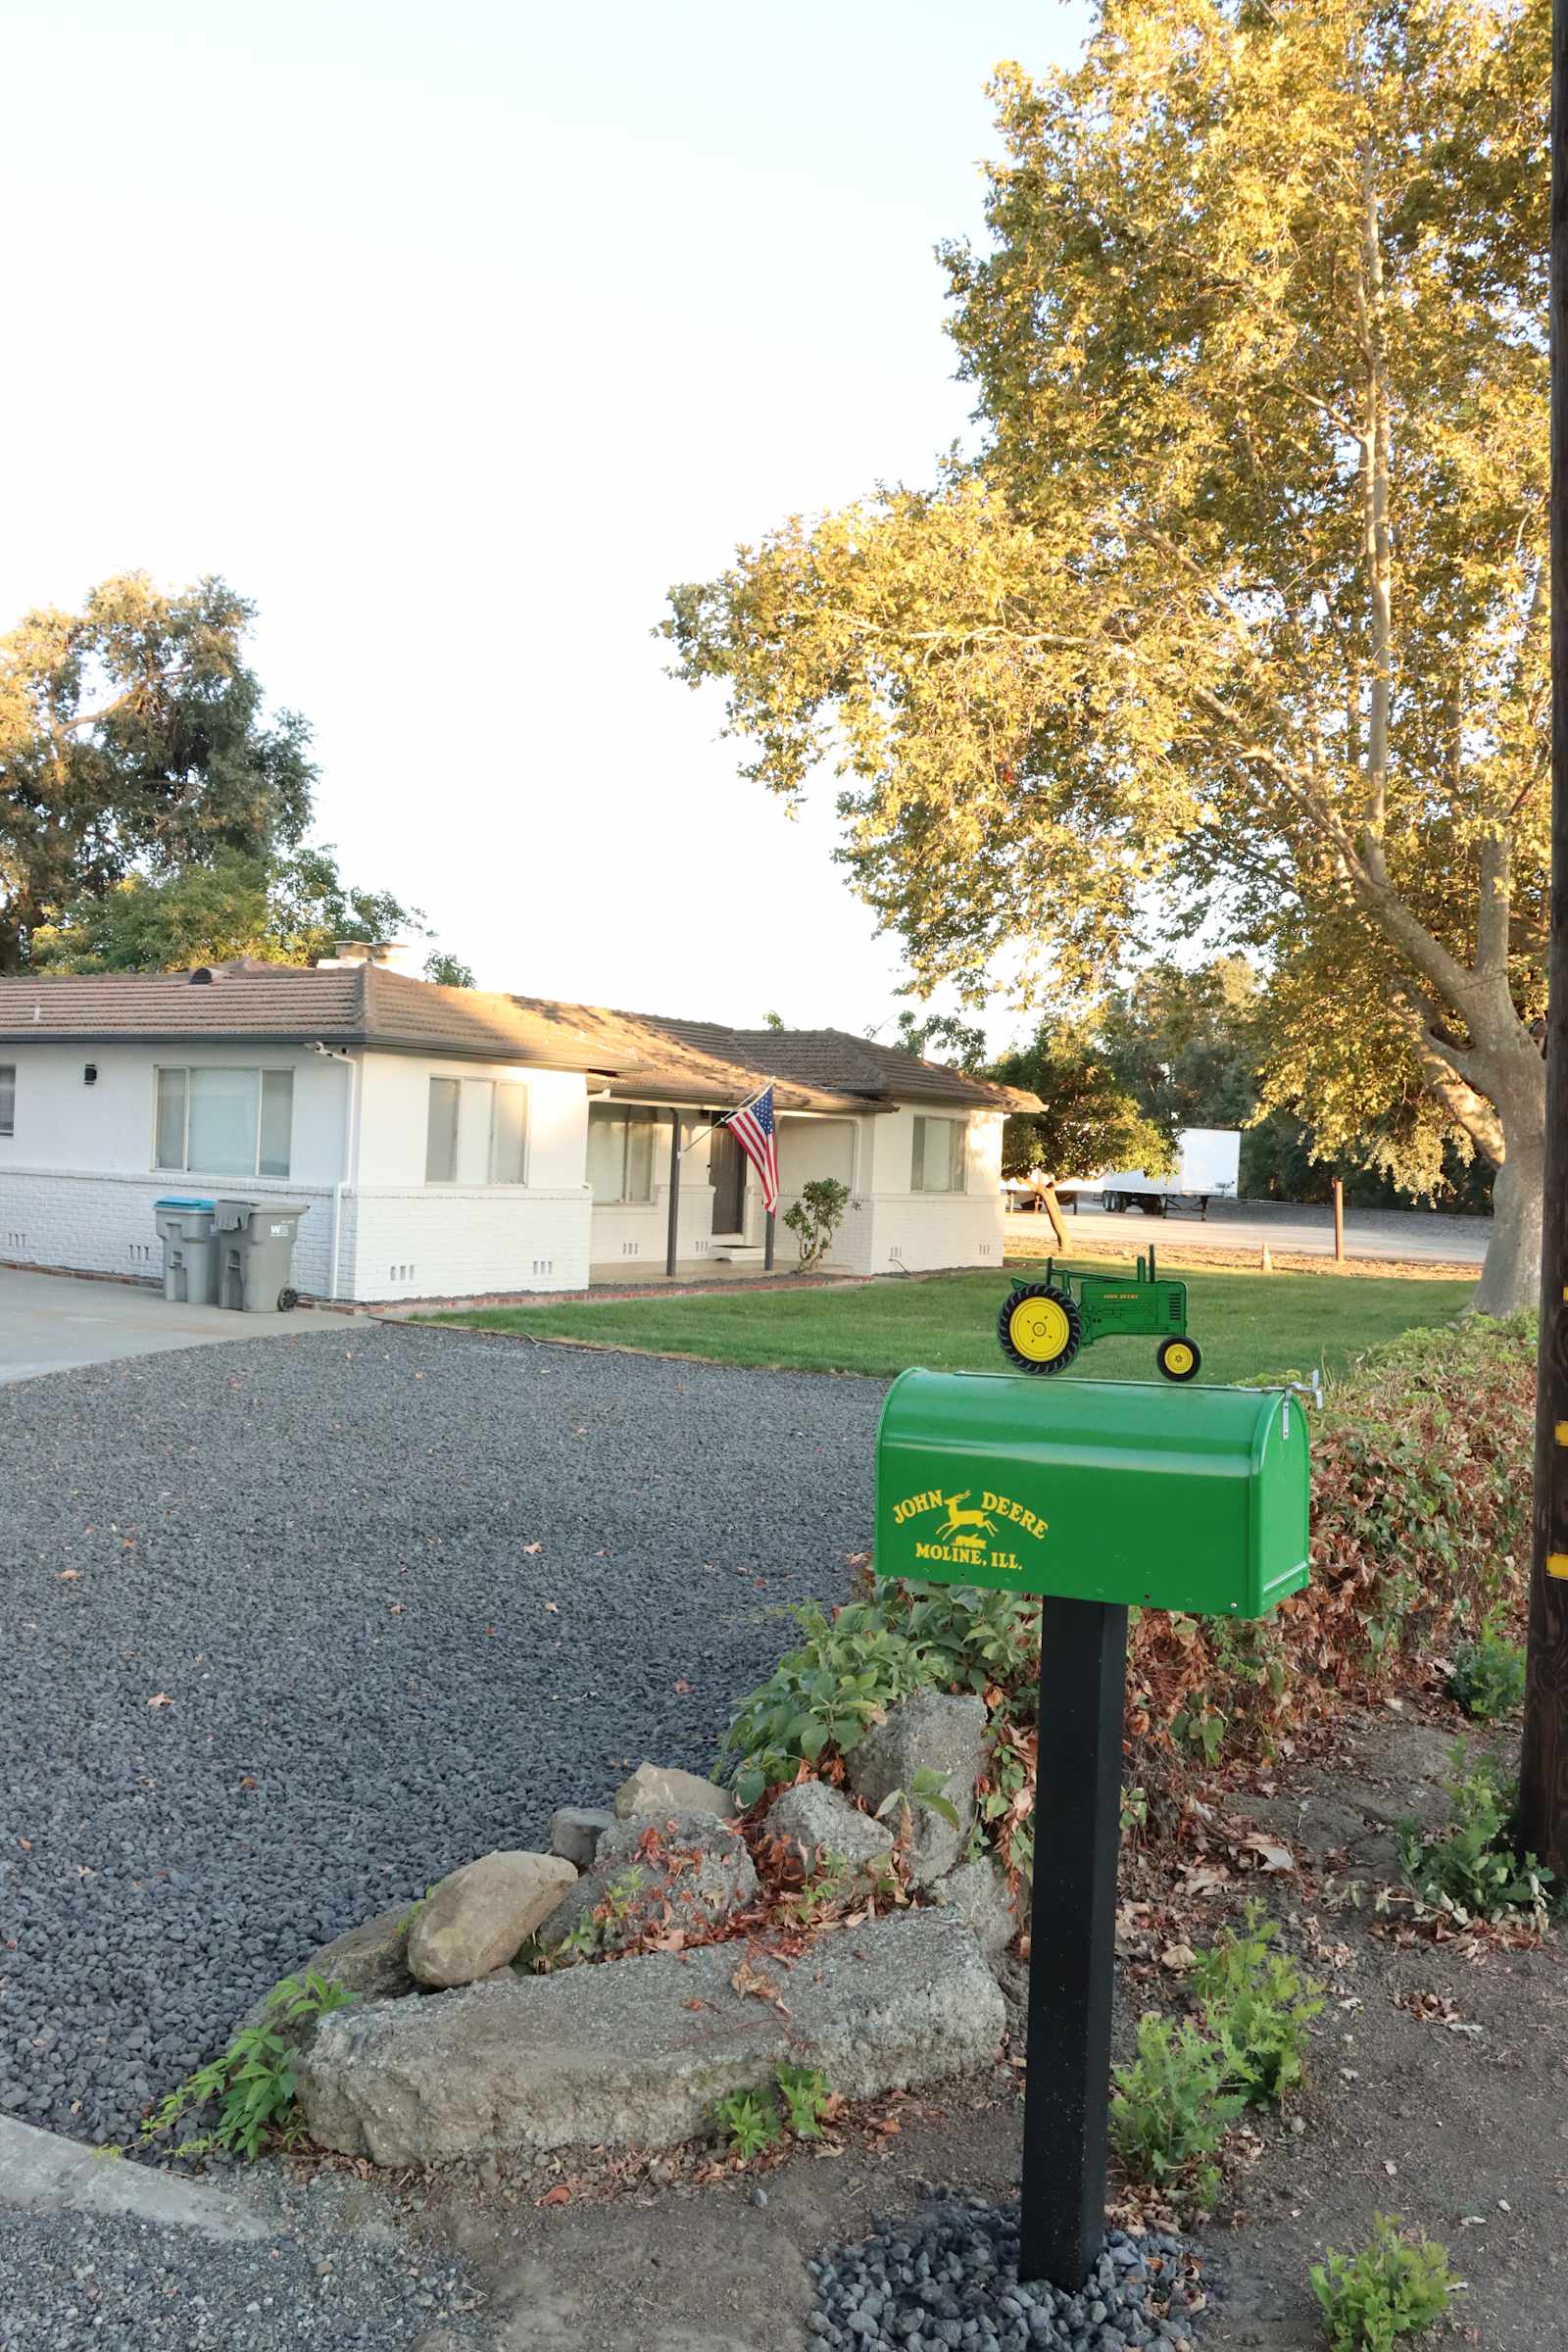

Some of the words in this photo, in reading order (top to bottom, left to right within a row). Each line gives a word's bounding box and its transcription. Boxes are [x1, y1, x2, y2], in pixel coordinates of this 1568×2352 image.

[893, 1490, 943, 1524] JOHN
[981, 1491, 1050, 1540] DEERE
[915, 1543, 988, 1567] MOLINE,
[991, 1551, 1023, 1570] ILL.
